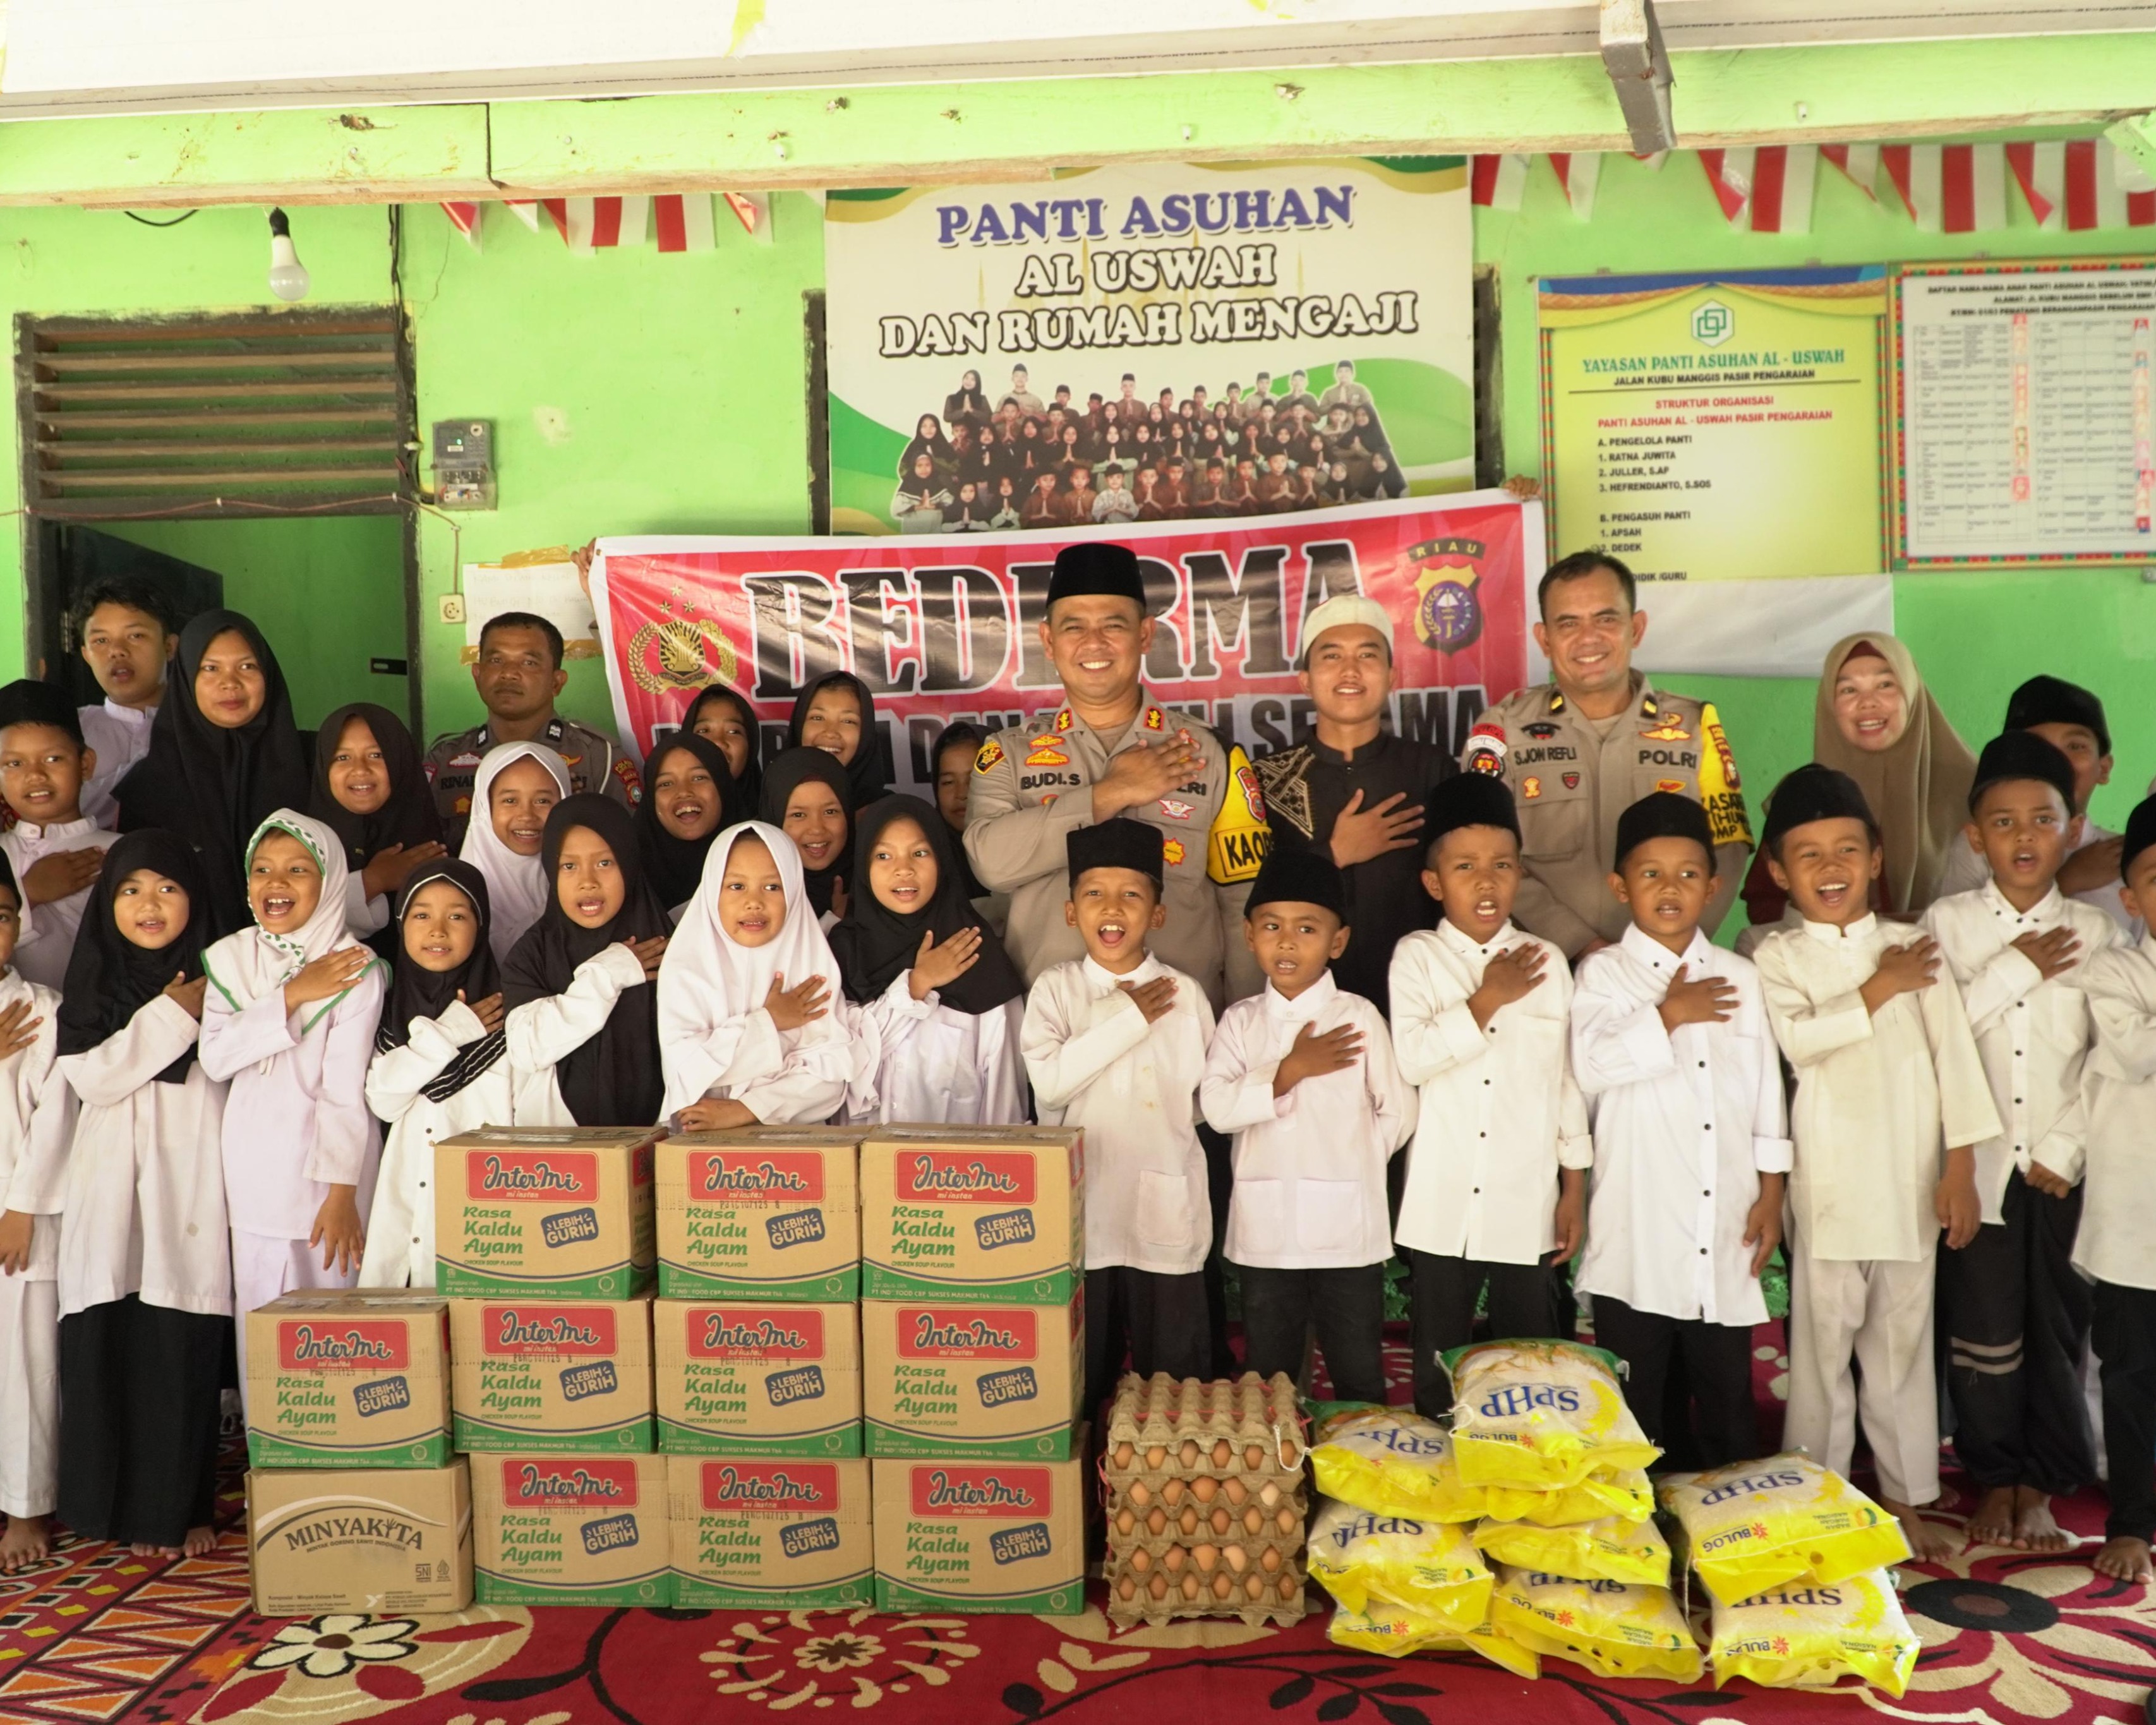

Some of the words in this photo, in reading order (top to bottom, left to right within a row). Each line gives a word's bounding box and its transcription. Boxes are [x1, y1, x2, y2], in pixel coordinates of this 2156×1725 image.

[937, 198, 1105, 247] PANTI
[1121, 186, 1357, 237] ASUHAN
[1015, 254, 1084, 298] AL
[1092, 244, 1277, 291] USWAH
[879, 312, 987, 358] DAN
[999, 303, 1181, 354] RUMAH
[1191, 291, 1419, 346] MENGAJI
[1583, 357, 1647, 373] YAYASAN
[1652, 355, 1693, 370] PANTI
[1698, 352, 1758, 369] ASUHAN
[1762, 351, 1780, 366] AL
[1793, 349, 1845, 364] USWAH
[1614, 376, 1644, 387] JALAN
[1647, 375, 1674, 385] KUBU
[1677, 373, 1720, 383] MANGGIS
[1724, 371, 1750, 382] PASIR
[1753, 370, 1815, 380] PENGARAIAN
[1656, 398, 1709, 409] STRUKTUR
[1713, 395, 1774, 407] ORGANISASI
[1598, 418, 1627, 428] PANTI
[1630, 417, 1672, 427] ASUHAN
[1675, 416, 1687, 425] AL
[1697, 414, 1733, 425] USWAH
[1735, 412, 1764, 424] PASIR
[1768, 411, 1833, 422] PENGARAIAN
[1598, 438, 1607, 447] A.
[1609, 436, 1663, 447] PENGELOLA
[1665, 435, 1692, 445] PANTI
[1599, 454, 1607, 462] 1.
[1609, 452, 1639, 462] RATNA
[1642, 451, 1676, 460] JUWITA
[1599, 468, 1607, 477] 2.
[1599, 483, 1607, 492] 3.
[1600, 514, 1610, 522] B.
[1611, 512, 1661, 522] PENGASUH
[1664, 511, 1690, 520] PANTI
[1601, 529, 1609, 538] 1.
[1611, 528, 1641, 538] APSAH
[1416, 541, 1477, 557] RIAU
[1611, 543, 1642, 552] DEDEK
[1639, 750, 1697, 769] POLRI
[462, 1206, 512, 1218] Rasa
[685, 1206, 736, 1220] Rasa
[891, 1206, 944, 1218] Rasa
[463, 1220, 522, 1237] Kaldu
[553, 1214, 584, 1230] LEBIH
[686, 1221, 747, 1238] Kaldu
[778, 1215, 810, 1231] LEBIH
[892, 1220, 955, 1237] Kaldu
[987, 1215, 1020, 1232] LEBIH
[546, 1225, 596, 1244] GURIH
[772, 1226, 822, 1246] GURIH
[980, 1227, 1032, 1246] GURIH
[463, 1237, 523, 1258] Ayam
[686, 1239, 748, 1259] Ayam
[891, 1239, 955, 1259] Ayam
[479, 1359, 530, 1373] Rasa
[684, 1364, 735, 1376] Rasa
[893, 1364, 946, 1377] Rasa
[275, 1375, 325, 1389] Rasa
[481, 1373, 541, 1391] Kaldu
[572, 1367, 603, 1383] LEBIH
[778, 1372, 810, 1388] LEBIH
[990, 1373, 1022, 1390] LEBIH
[365, 1383, 395, 1399] LEBIH
[565, 1378, 614, 1398] GURIH
[684, 1378, 746, 1395] Kaldu
[771, 1383, 822, 1402] GURIH
[894, 1378, 957, 1396] Kaldu
[983, 1384, 1034, 1404] GURIH
[277, 1389, 335, 1408] Kaldu
[359, 1393, 407, 1414] GURIH
[480, 1391, 541, 1412] Ayam
[684, 1395, 747, 1415] Ayam
[894, 1397, 957, 1417] Ayam
[1481, 1386, 1579, 1417] SPHP
[277, 1407, 336, 1428] Ayam
[1702, 1472, 1804, 1505] SPHP
[500, 1513, 551, 1527] Rasa
[593, 1520, 624, 1537] LEBIH
[698, 1516, 750, 1529] Rasa
[906, 1522, 959, 1535] Rasa
[501, 1527, 562, 1546] Kaldu
[586, 1530, 635, 1551] GURIH
[699, 1530, 761, 1547] Kaldu
[792, 1524, 824, 1540] LEBIH
[1003, 1530, 1036, 1546] LEBIH
[1702, 1528, 1752, 1552] BULOG
[786, 1535, 836, 1554] GURIH
[906, 1536, 970, 1554] Kaldu
[996, 1541, 1048, 1561] GURIH
[500, 1545, 562, 1566] Ayam
[699, 1548, 761, 1568] Ayam
[416, 1566, 431, 1577] SNI
[906, 1554, 970, 1575] Ayam
